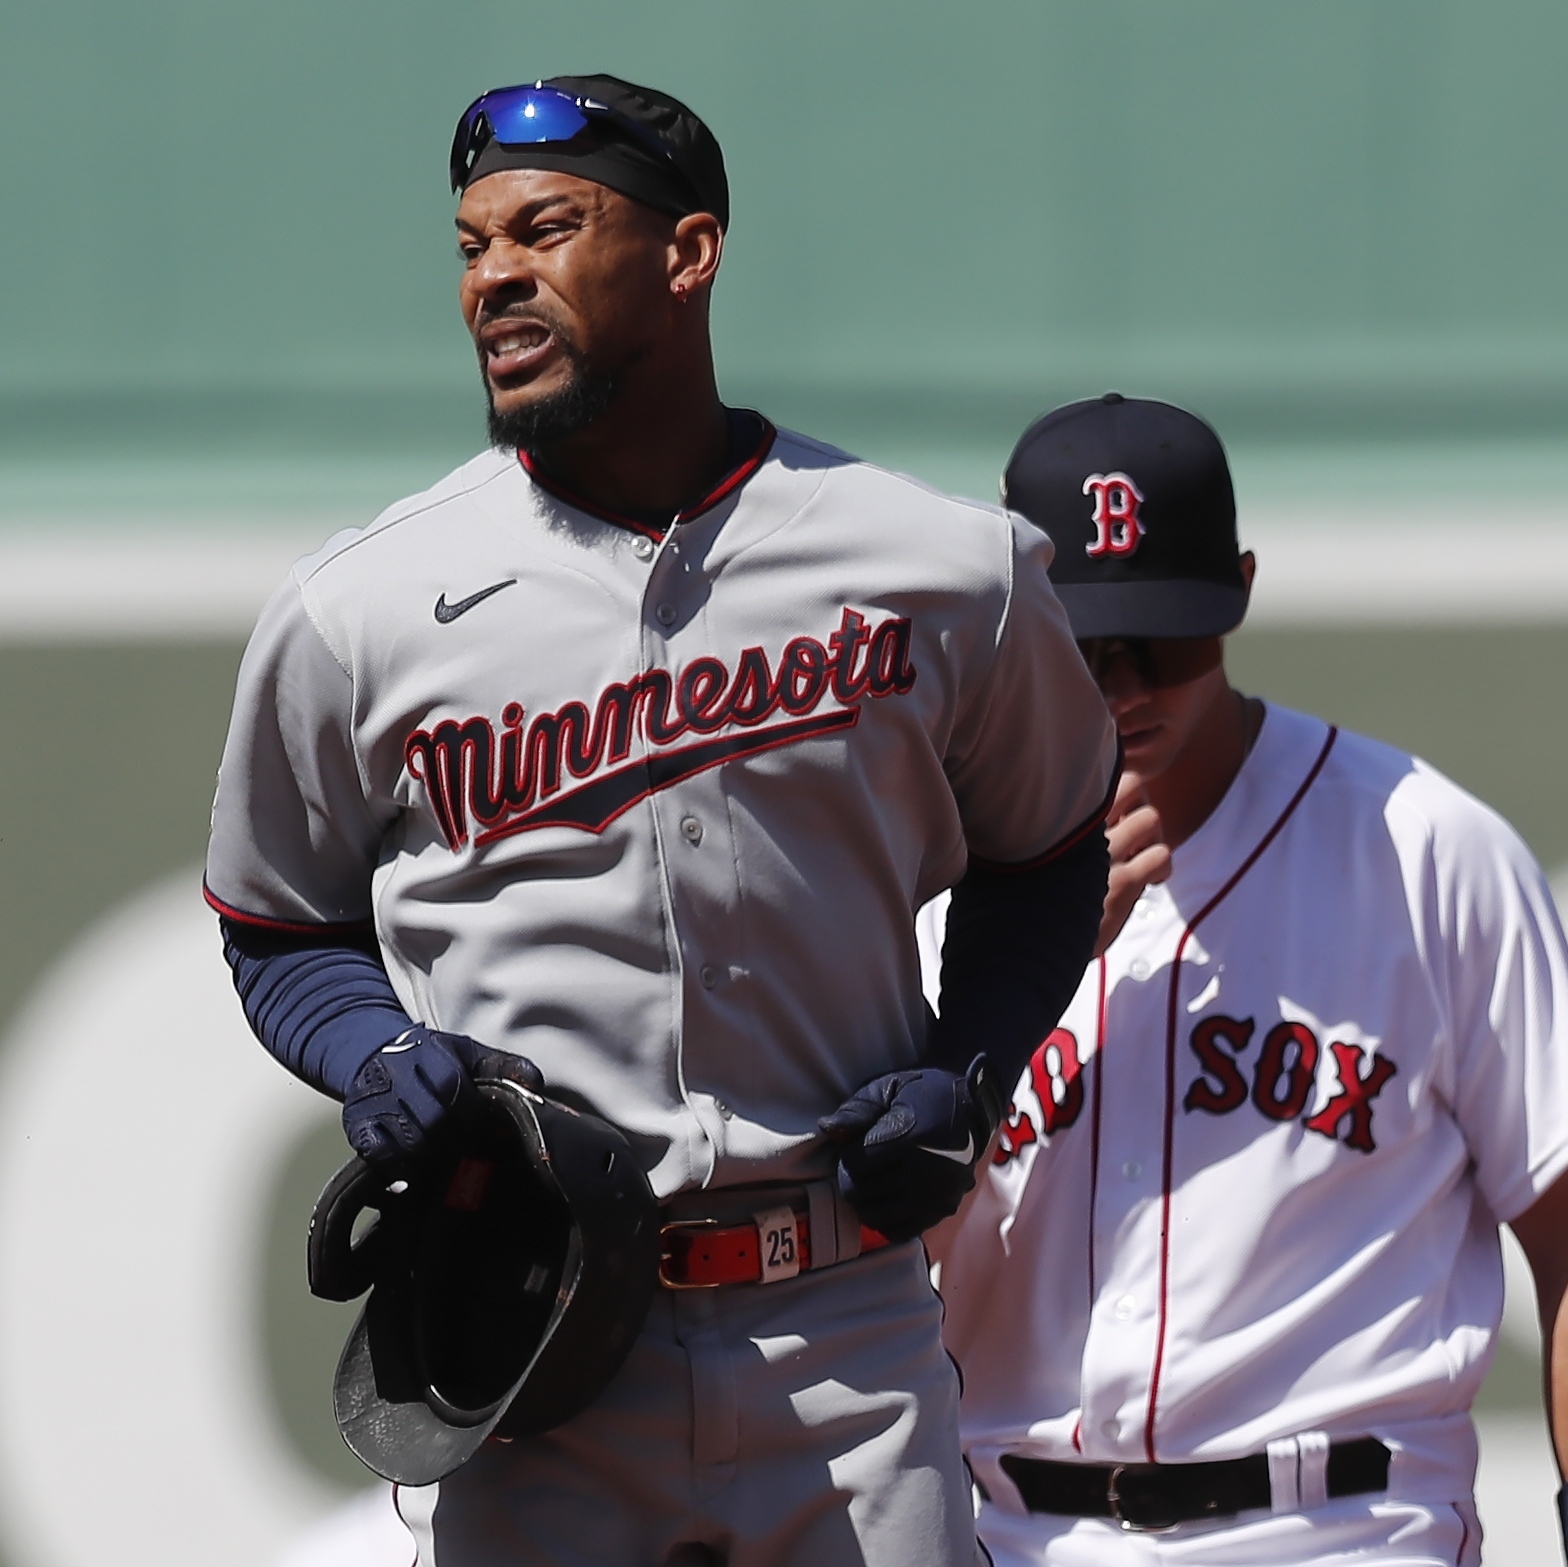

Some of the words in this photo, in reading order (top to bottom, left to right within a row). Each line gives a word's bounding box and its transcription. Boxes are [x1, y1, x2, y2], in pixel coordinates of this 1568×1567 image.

[1082, 472, 1145, 559] B
[405, 606, 918, 852] Minnesota
[1184, 1015, 1398, 1154] SOX
[766, 1227, 795, 1267] 25
